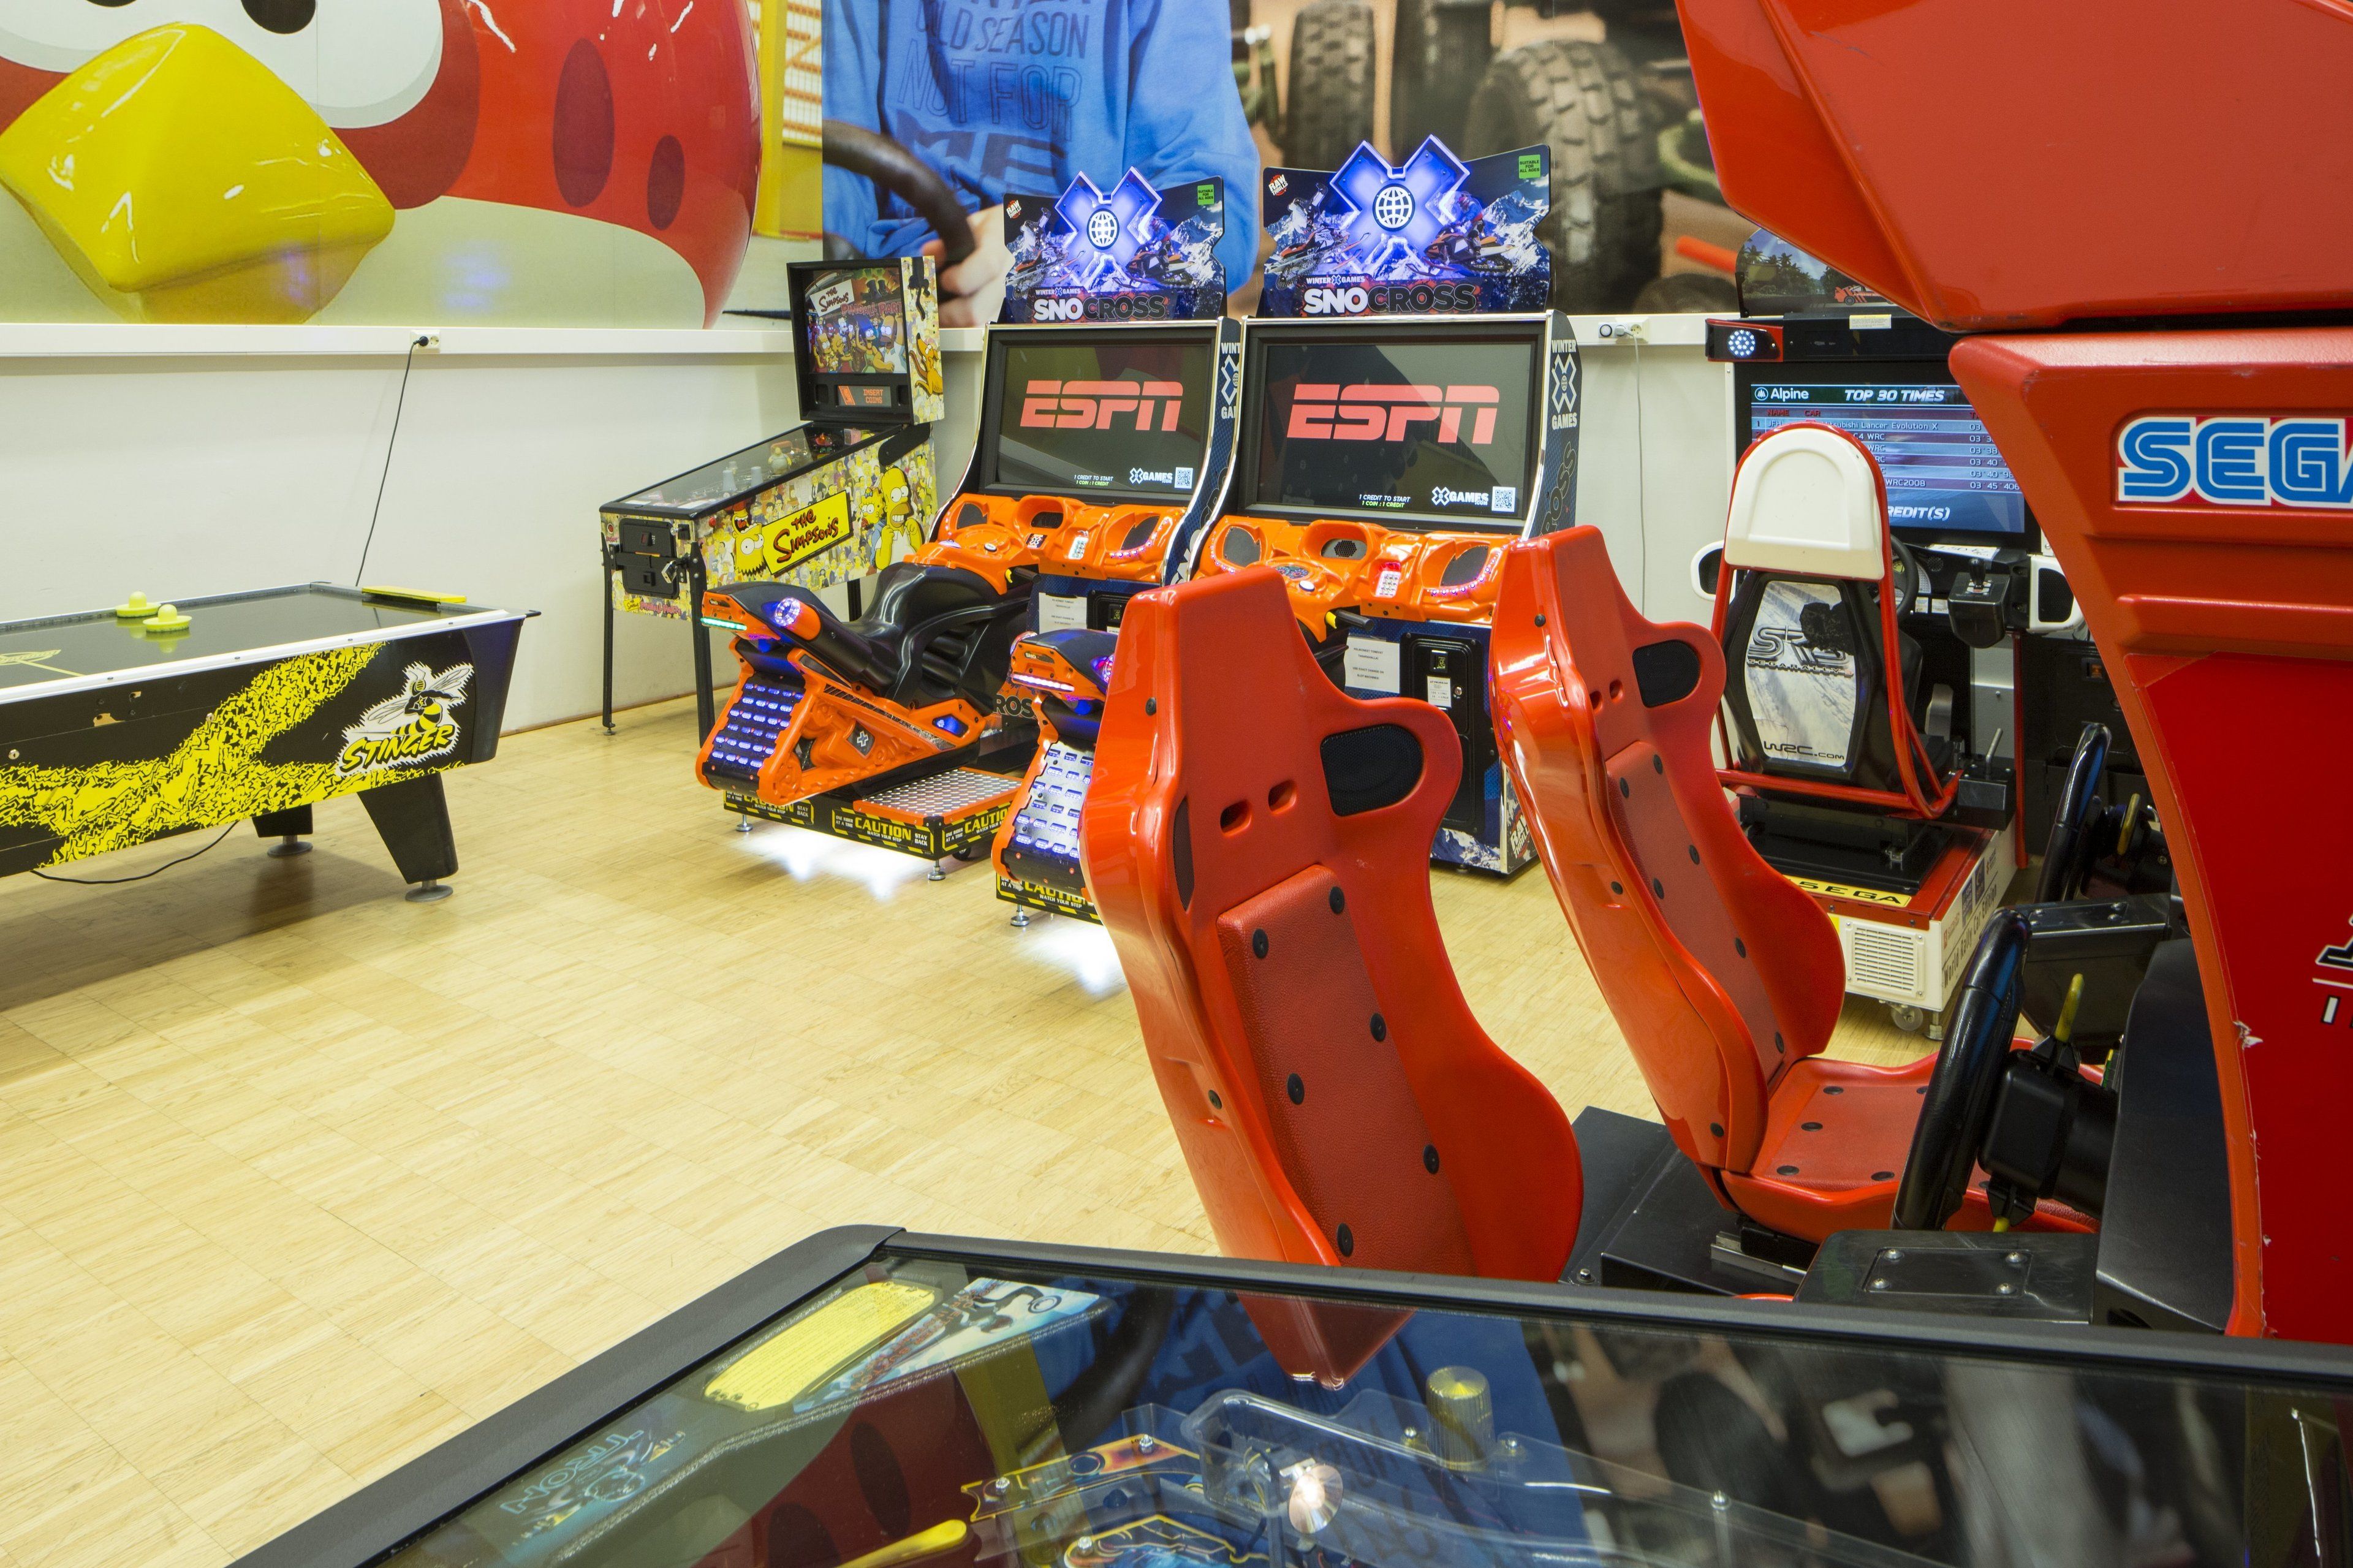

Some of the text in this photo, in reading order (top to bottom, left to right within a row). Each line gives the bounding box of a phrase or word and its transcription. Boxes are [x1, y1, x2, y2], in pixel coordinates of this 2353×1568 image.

[974, 10, 1089, 59] SEASON
[898, 38, 1082, 141] NOT FOR
[1268, 174, 1288, 192] RAW
[1006, 200, 1021, 214] RAW
[878, 301, 902, 315] PART
[1221, 343, 1240, 354] WINT
[1552, 339, 1577, 353] WINTER
[1020, 380, 1183, 431] ESPN
[1770, 387, 1809, 402] Alpine
[1844, 390, 1945, 402] TOP 30 TIMES
[1287, 384, 1499, 444] ESPN
[1552, 412, 1577, 430] GAMES
[2118, 417, 2353, 509] SEG
[1886, 479, 1927, 487] WRC2008
[1449, 491, 1489, 502] GAMES
[791, 509, 816, 530] THE
[1887, 506, 1950, 521] REDIT(S)
[773, 517, 839, 563] SIMPSONS
[993, 693, 1037, 719] ROS
[339, 724, 455, 773] STINGER
[855, 817, 911, 841] CAUTION
[964, 808, 1008, 833] CAUTIO
[1039, 893, 1056, 902] WATCH
[1798, 881, 1901, 904] SEGA
[1943, 950, 1960, 988] World
[1960, 925, 1972, 958] Rally
[500, 1430, 644, 1514] TRON
